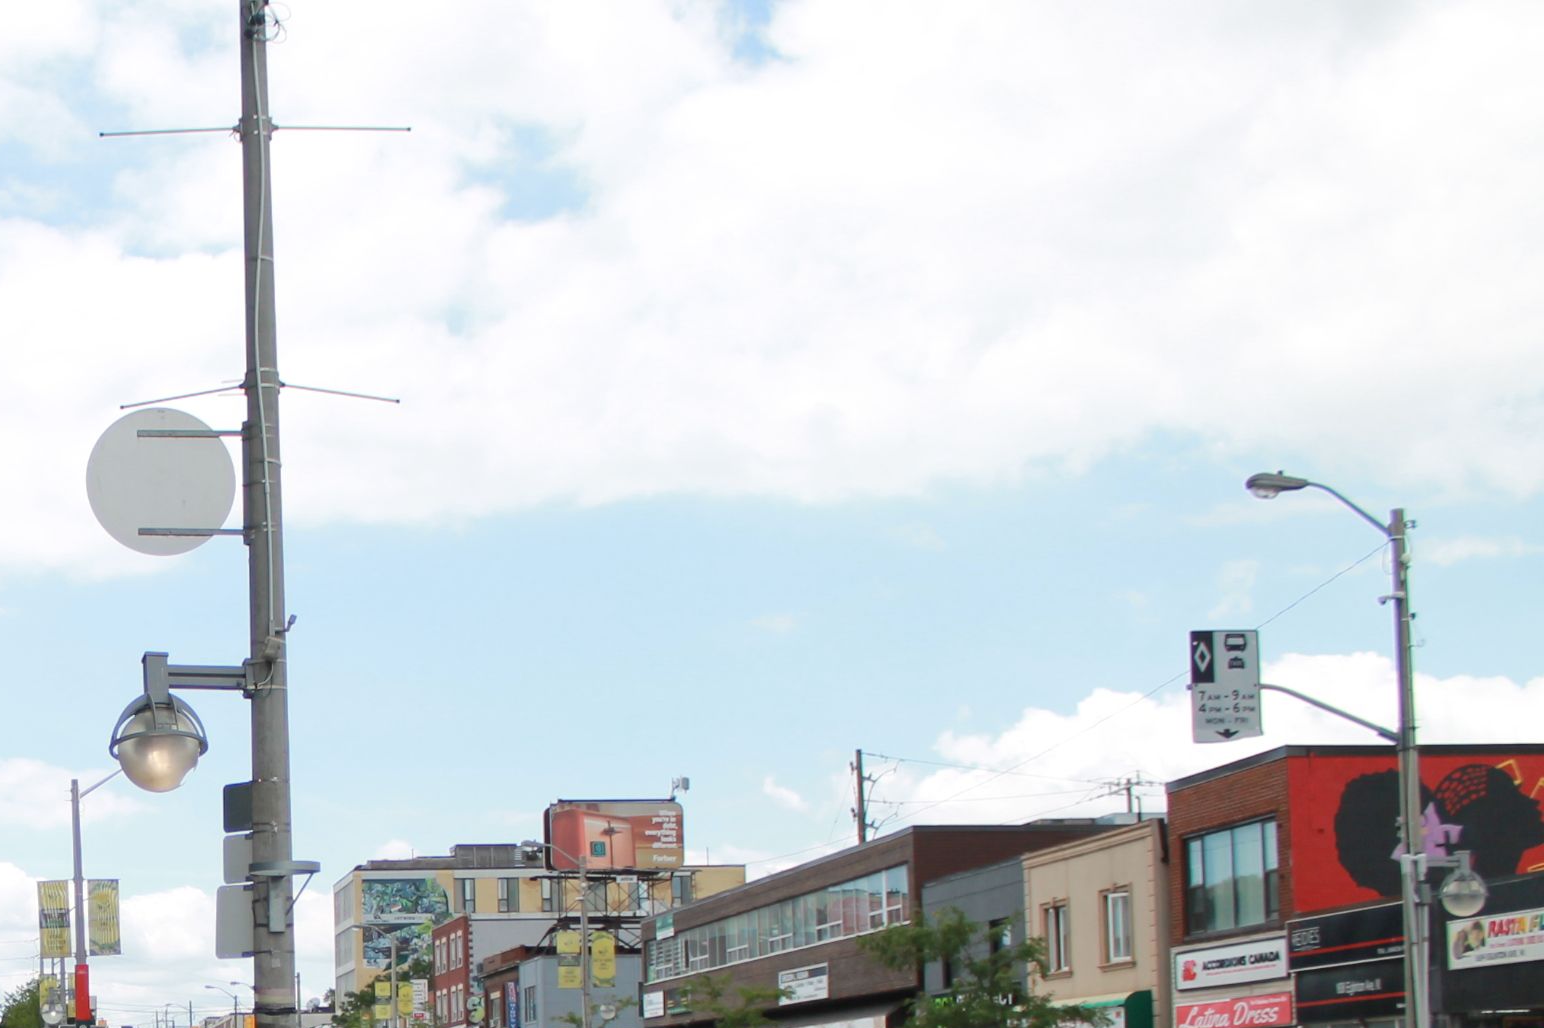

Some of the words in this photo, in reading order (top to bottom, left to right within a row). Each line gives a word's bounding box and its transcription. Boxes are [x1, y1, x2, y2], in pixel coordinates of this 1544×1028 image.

[1198, 690, 1206, 700] 7
[1198, 703, 1206, 713] 4
[1232, 702, 1240, 713] 6
[1248, 950, 1280, 965] CANADA
[1233, 1001, 1280, 1026] Dress
